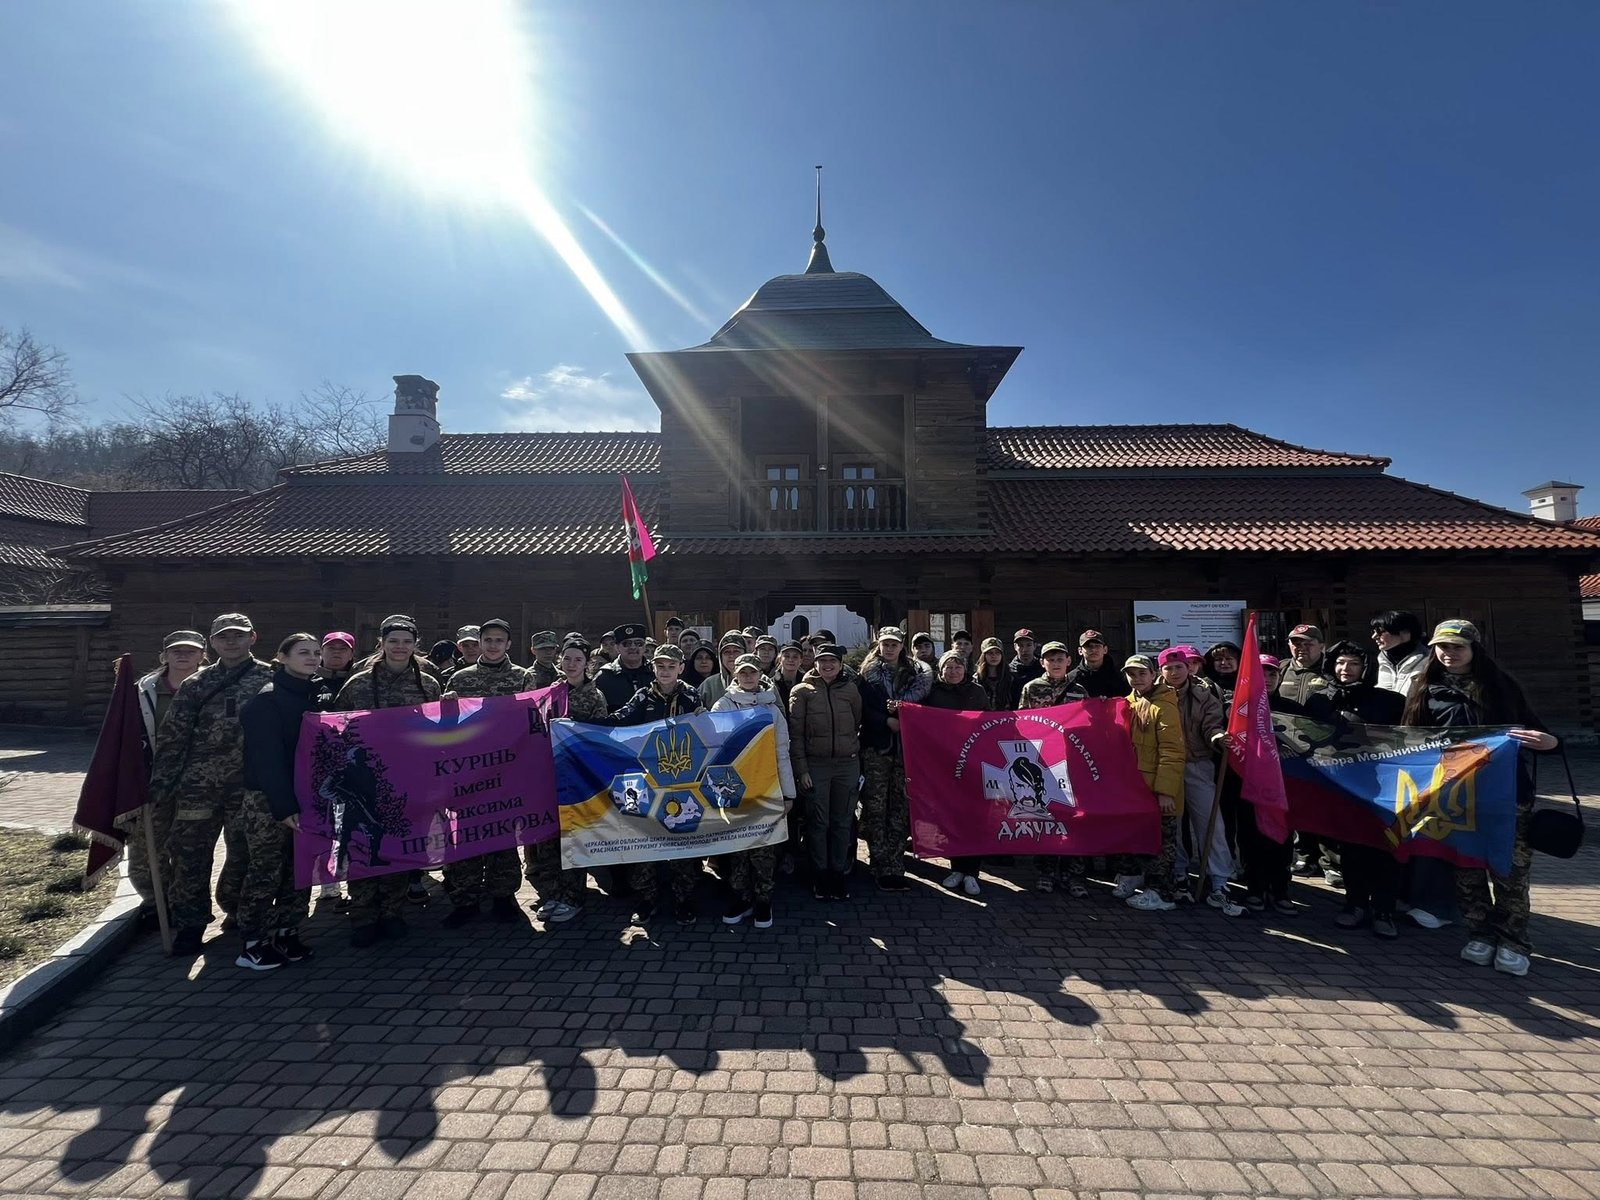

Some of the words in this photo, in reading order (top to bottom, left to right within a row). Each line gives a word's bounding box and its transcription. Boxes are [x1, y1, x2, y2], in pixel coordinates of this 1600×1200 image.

[1014, 742, 1027, 753] Ш
[1357, 737, 1451, 763] Мельниченка
[433, 748, 516, 777] КУРІНЬ
[453, 773, 502, 798] імені
[986, 779, 999, 790] М
[435, 796, 524, 824] Максима
[401, 810, 555, 856] ПРЕСНЯКОВА
[584, 839, 619, 848] ЧЕРКАСЬКИЙ
[619, 836, 648, 845] ОБЛАСНИЙ
